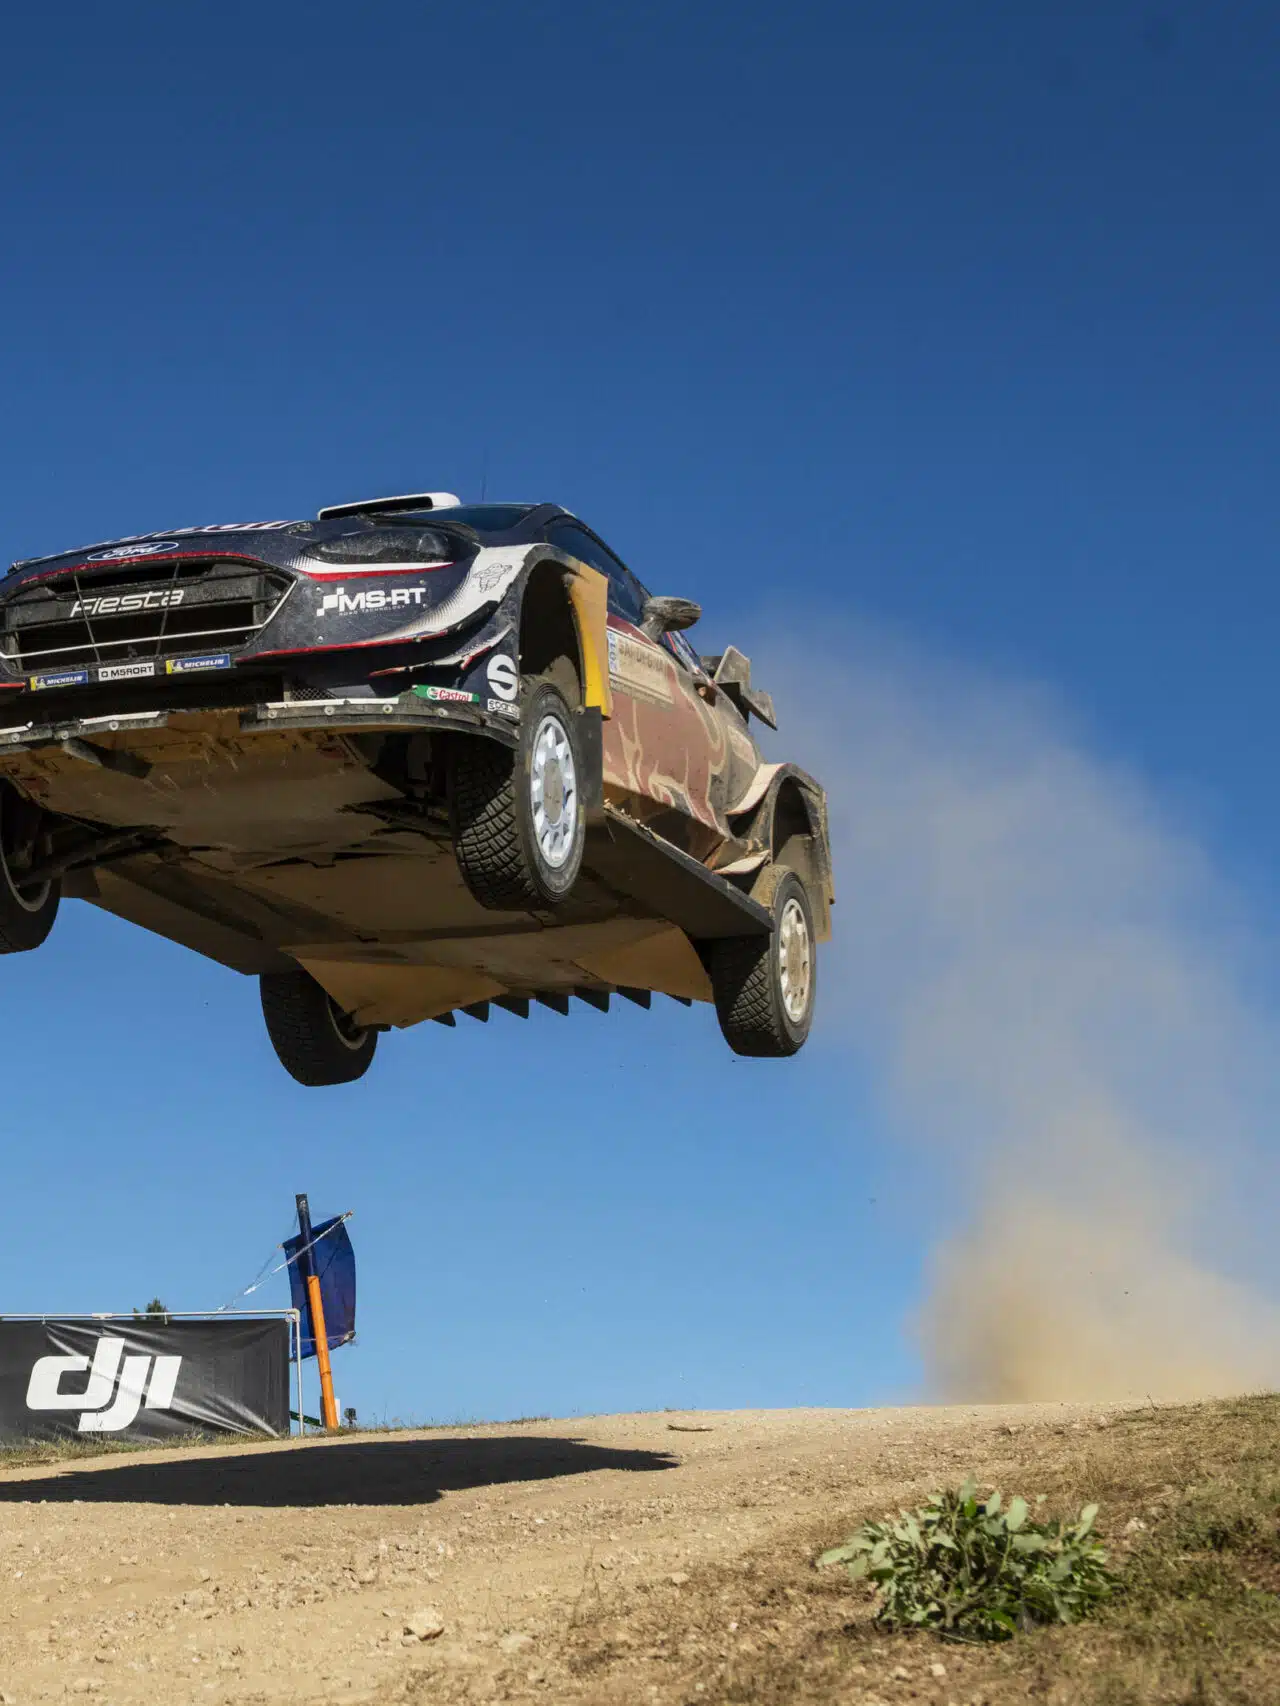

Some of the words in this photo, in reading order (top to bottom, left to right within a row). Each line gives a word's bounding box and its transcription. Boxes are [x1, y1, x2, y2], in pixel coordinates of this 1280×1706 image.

[339, 587, 426, 612] MS-RT
[184, 658, 225, 669] MICHELIN
[46, 674, 84, 686] MICHELIN
